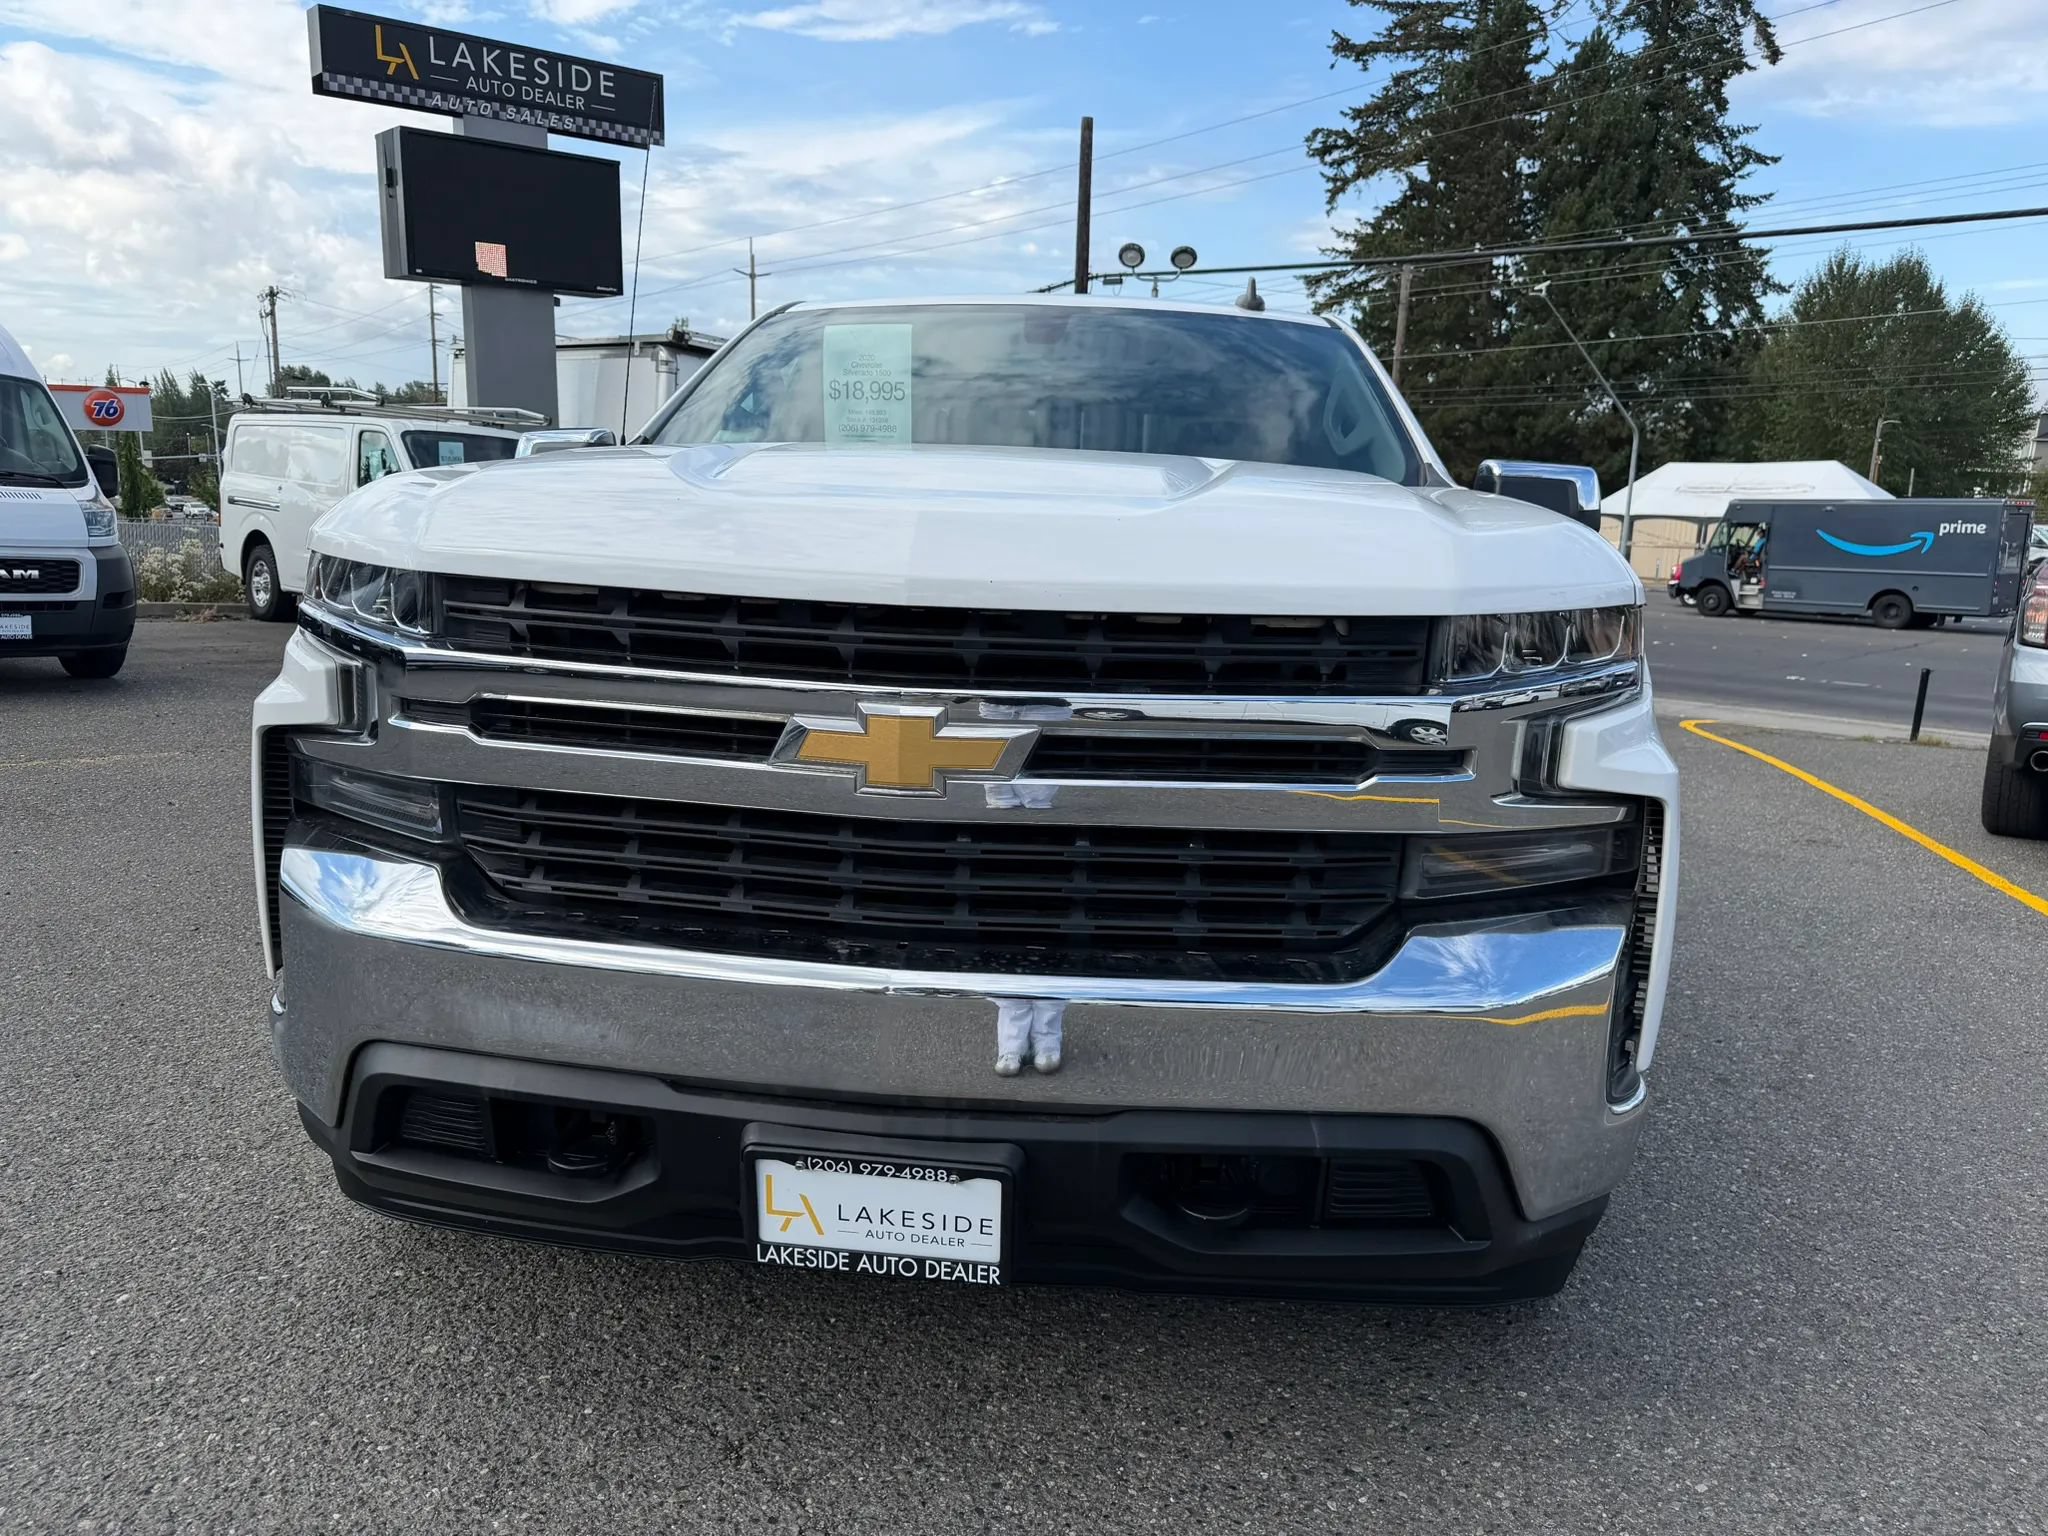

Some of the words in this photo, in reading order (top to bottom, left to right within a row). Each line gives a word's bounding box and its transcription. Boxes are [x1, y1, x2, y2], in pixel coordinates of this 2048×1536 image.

[429, 36, 616, 98] LAKESIDE
[466, 75, 515, 99] AUTO
[522, 86, 586, 111] DEALER
[431, 94, 492, 116] AUTO
[506, 106, 577, 131] SALES
[828, 378, 906, 405] $18,995
[91, 398, 121, 419] 76
[1939, 519, 1987, 537] prime
[0, 568, 40, 580] AM
[806, 1156, 853, 1175] (206)
[859, 1163, 948, 1183] 979-4988
[837, 1203, 994, 1236] LAKESIDE
[865, 1229, 905, 1243] AUTO
[911, 1233, 965, 1248] DEALER
[756, 1244, 850, 1272] LAKESIDE
[856, 1253, 918, 1278] AUTO
[925, 1260, 1001, 1286] DEALER
